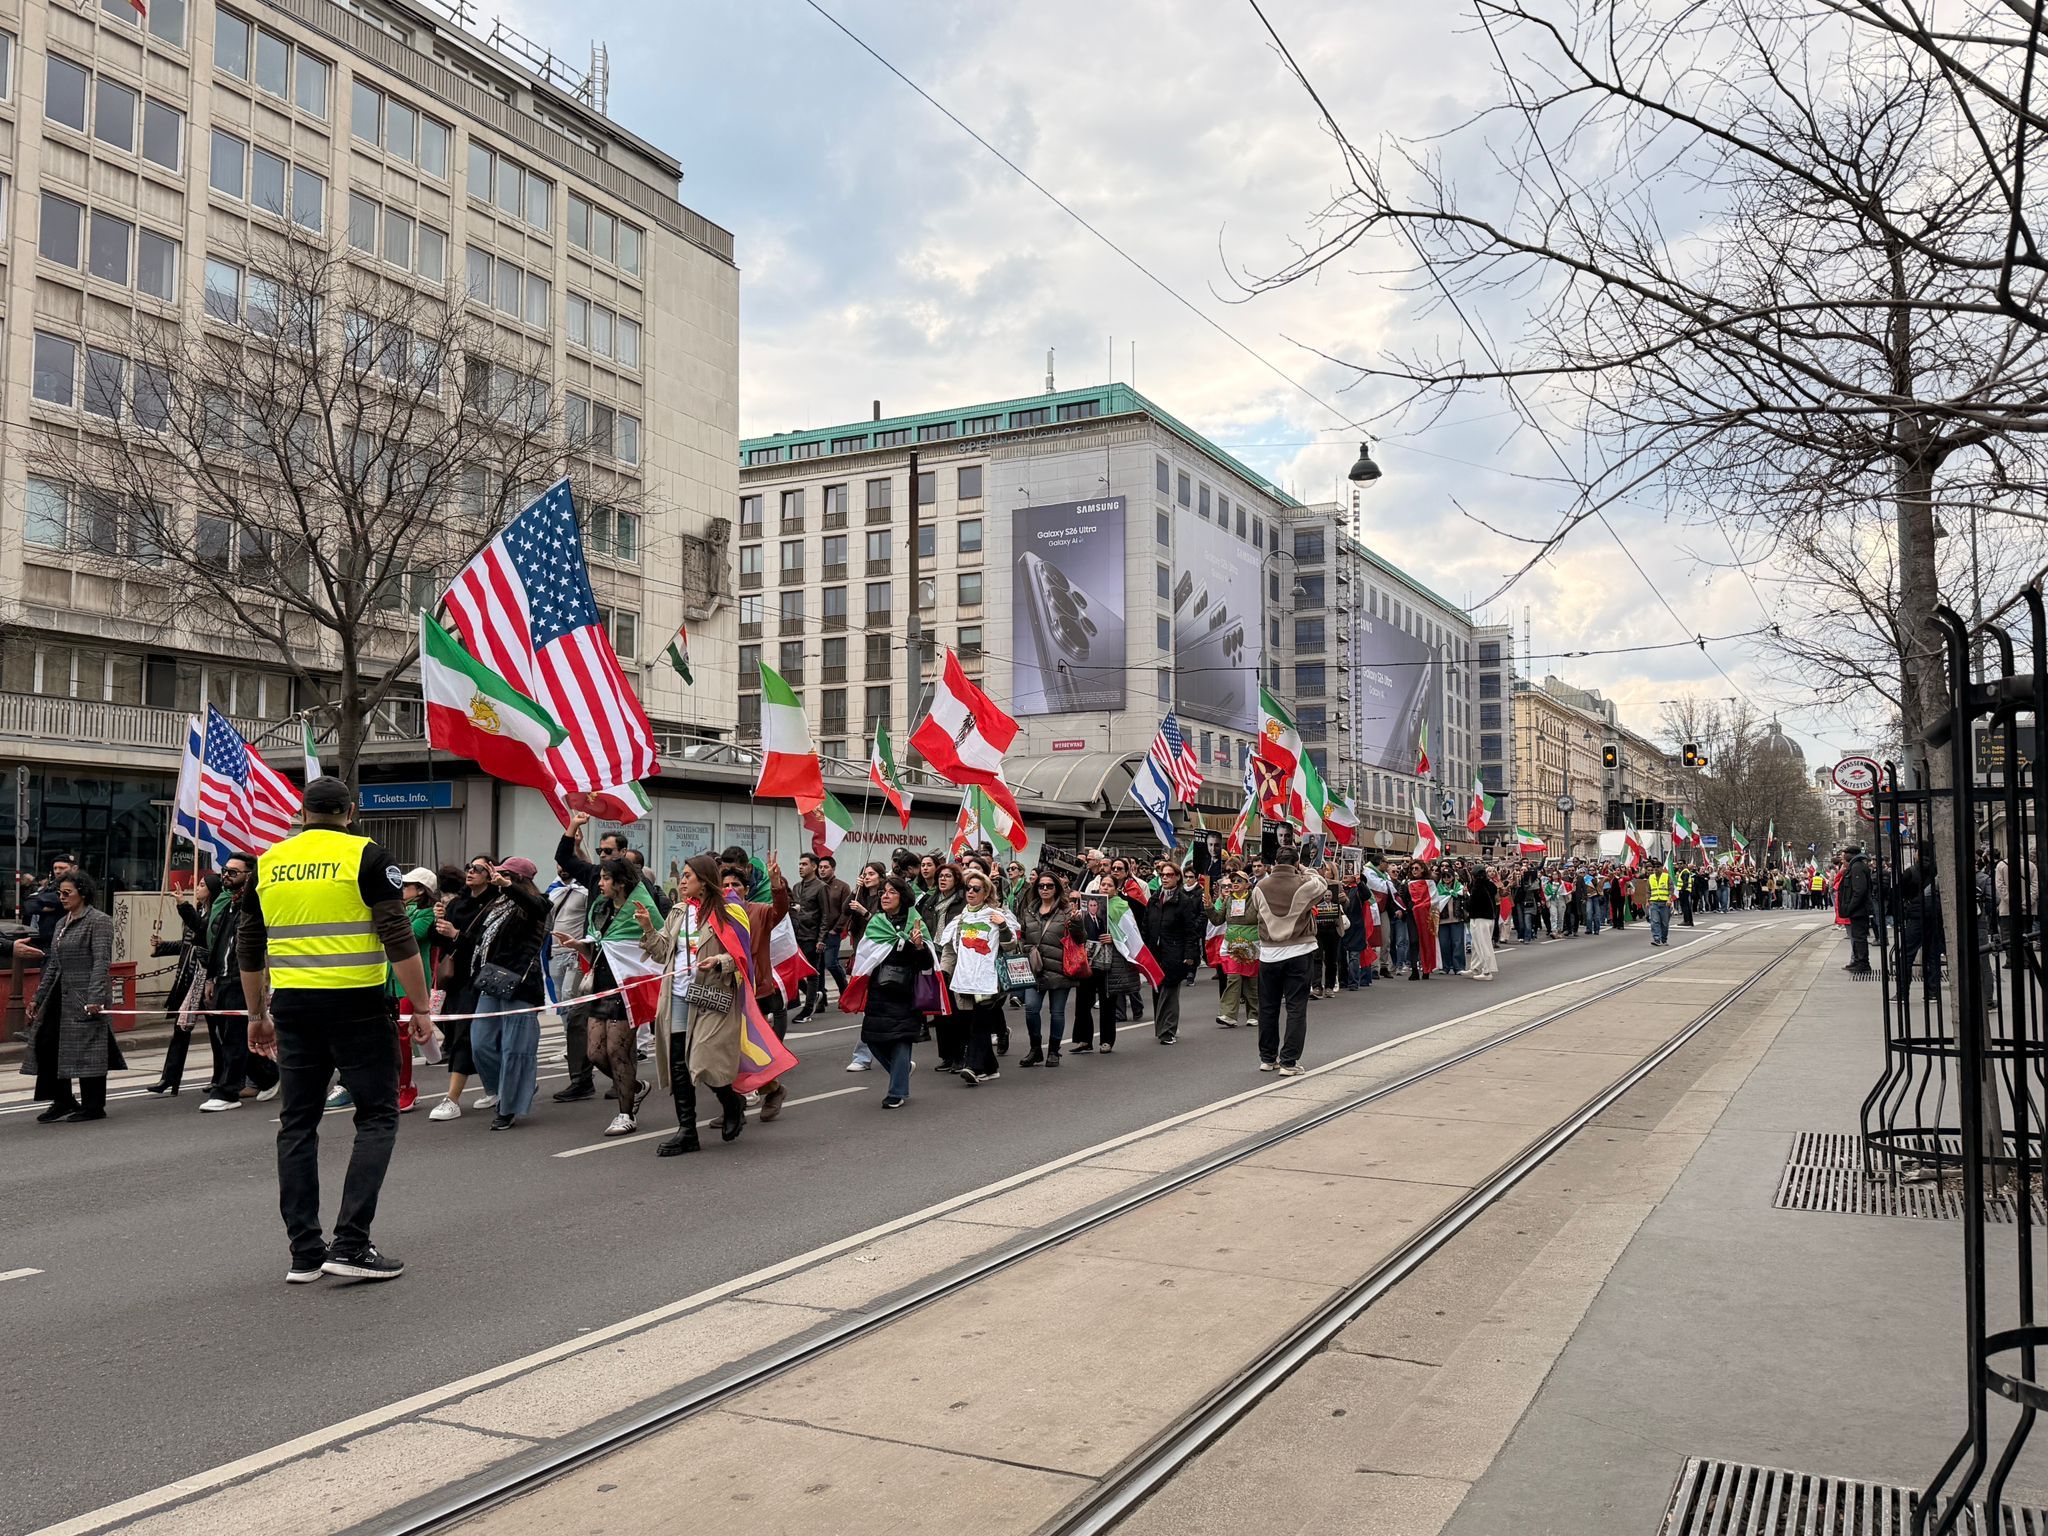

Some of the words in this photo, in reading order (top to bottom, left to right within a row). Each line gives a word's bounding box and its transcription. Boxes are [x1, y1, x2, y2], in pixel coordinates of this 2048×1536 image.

[1076, 501, 1119, 514] SAMSUNG
[1037, 529, 1065, 540] Galaxy
[1065, 527, 1078, 536] S26
[1078, 525, 1097, 534] Ultra
[1048, 538, 1071, 548] Galaxy
[1840, 778, 1873, 789] HALTESTELL
[373, 794, 408, 804] Tickets.
[408, 793, 429, 803] Info.
[909, 835, 928, 847] RING
[271, 863, 341, 883] SECURITY
